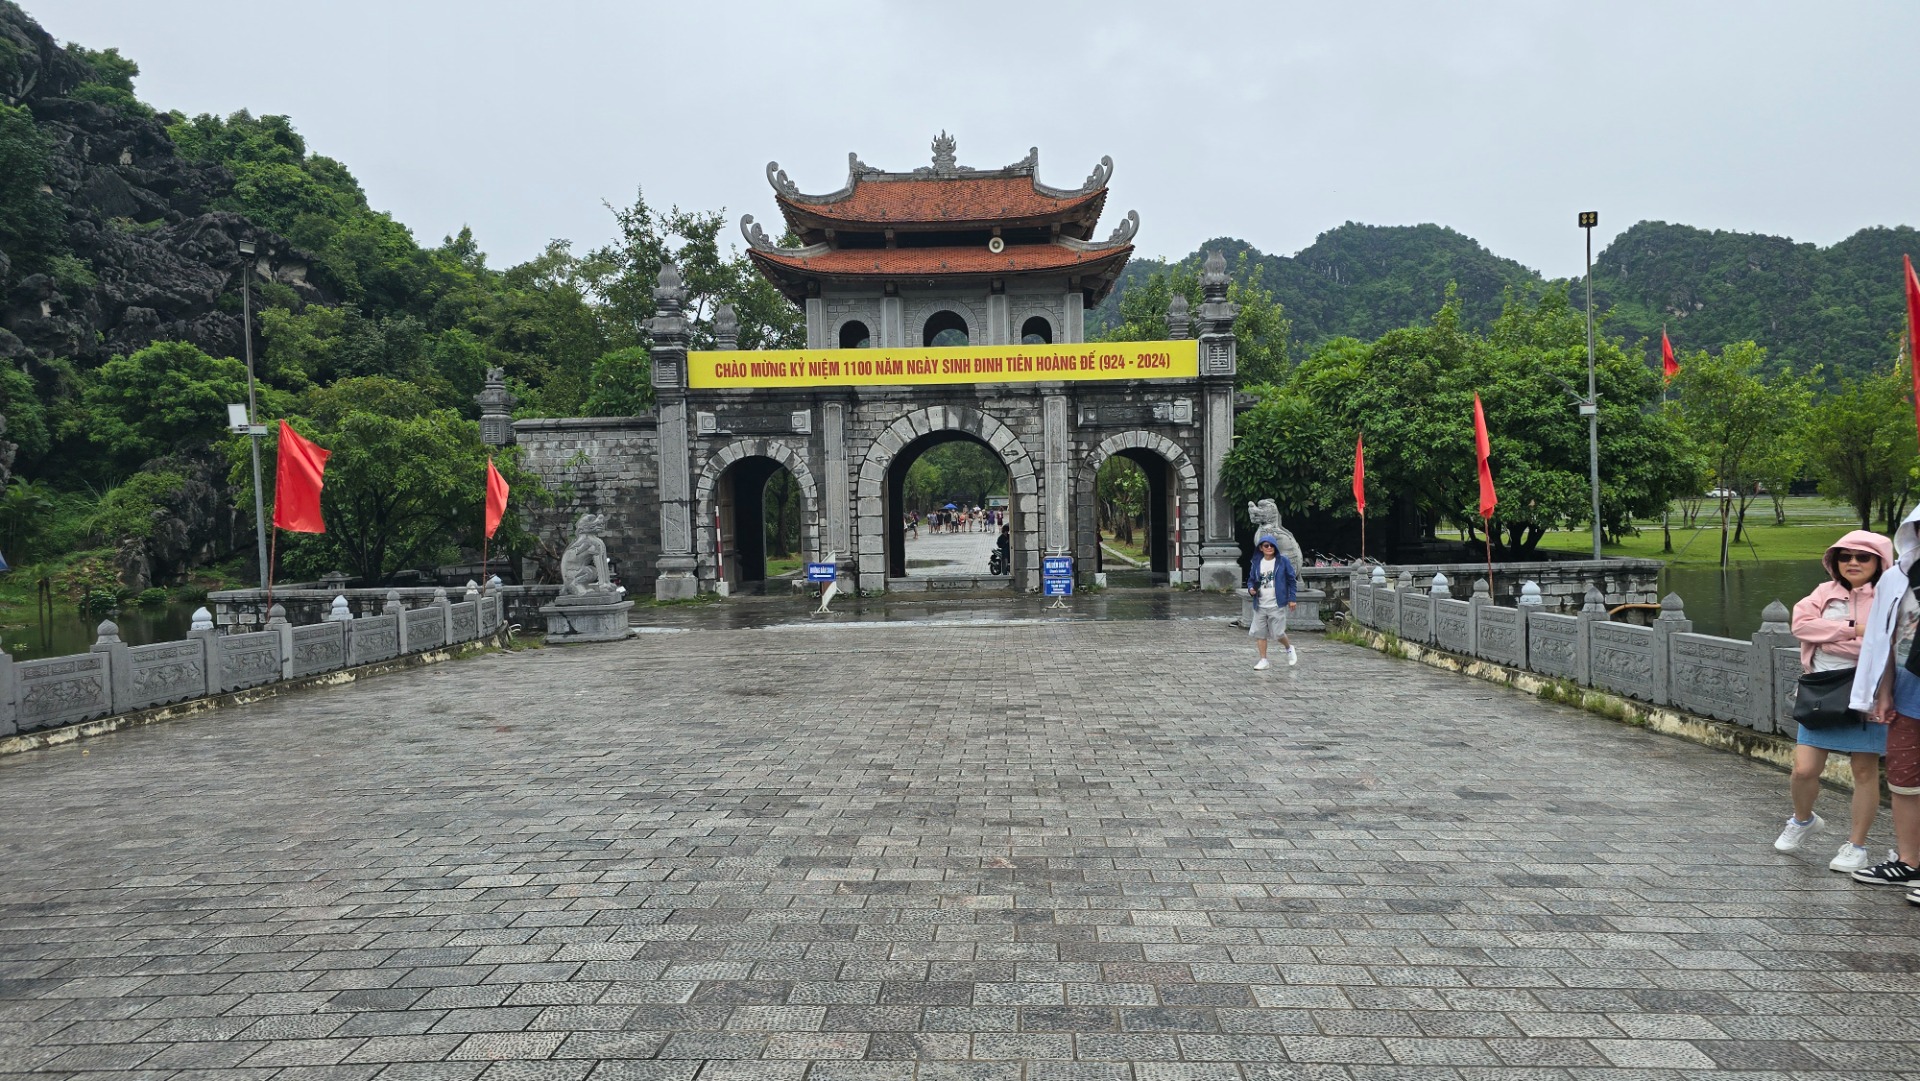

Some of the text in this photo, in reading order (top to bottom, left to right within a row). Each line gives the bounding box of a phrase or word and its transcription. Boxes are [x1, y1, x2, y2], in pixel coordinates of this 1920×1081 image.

[715, 360, 747, 378] CHÀO
[751, 359, 787, 378] MỪNG
[790, 357, 805, 377] KỶ
[809, 358, 840, 379] NIỆM
[844, 361, 872, 376] 1100
[876, 357, 904, 375] NĂM
[907, 356, 939, 375] NGÀY
[942, 358, 971, 374] SINH
[974, 357, 1003, 373] ĐINH
[1006, 354, 1033, 372] TIÊN
[1036, 353, 1077, 371] HOÀNG
[1080, 350, 1096, 371] ĐẾ
[1099, 354, 1126, 371] (924
[1137, 353, 1170, 369] 2024)
